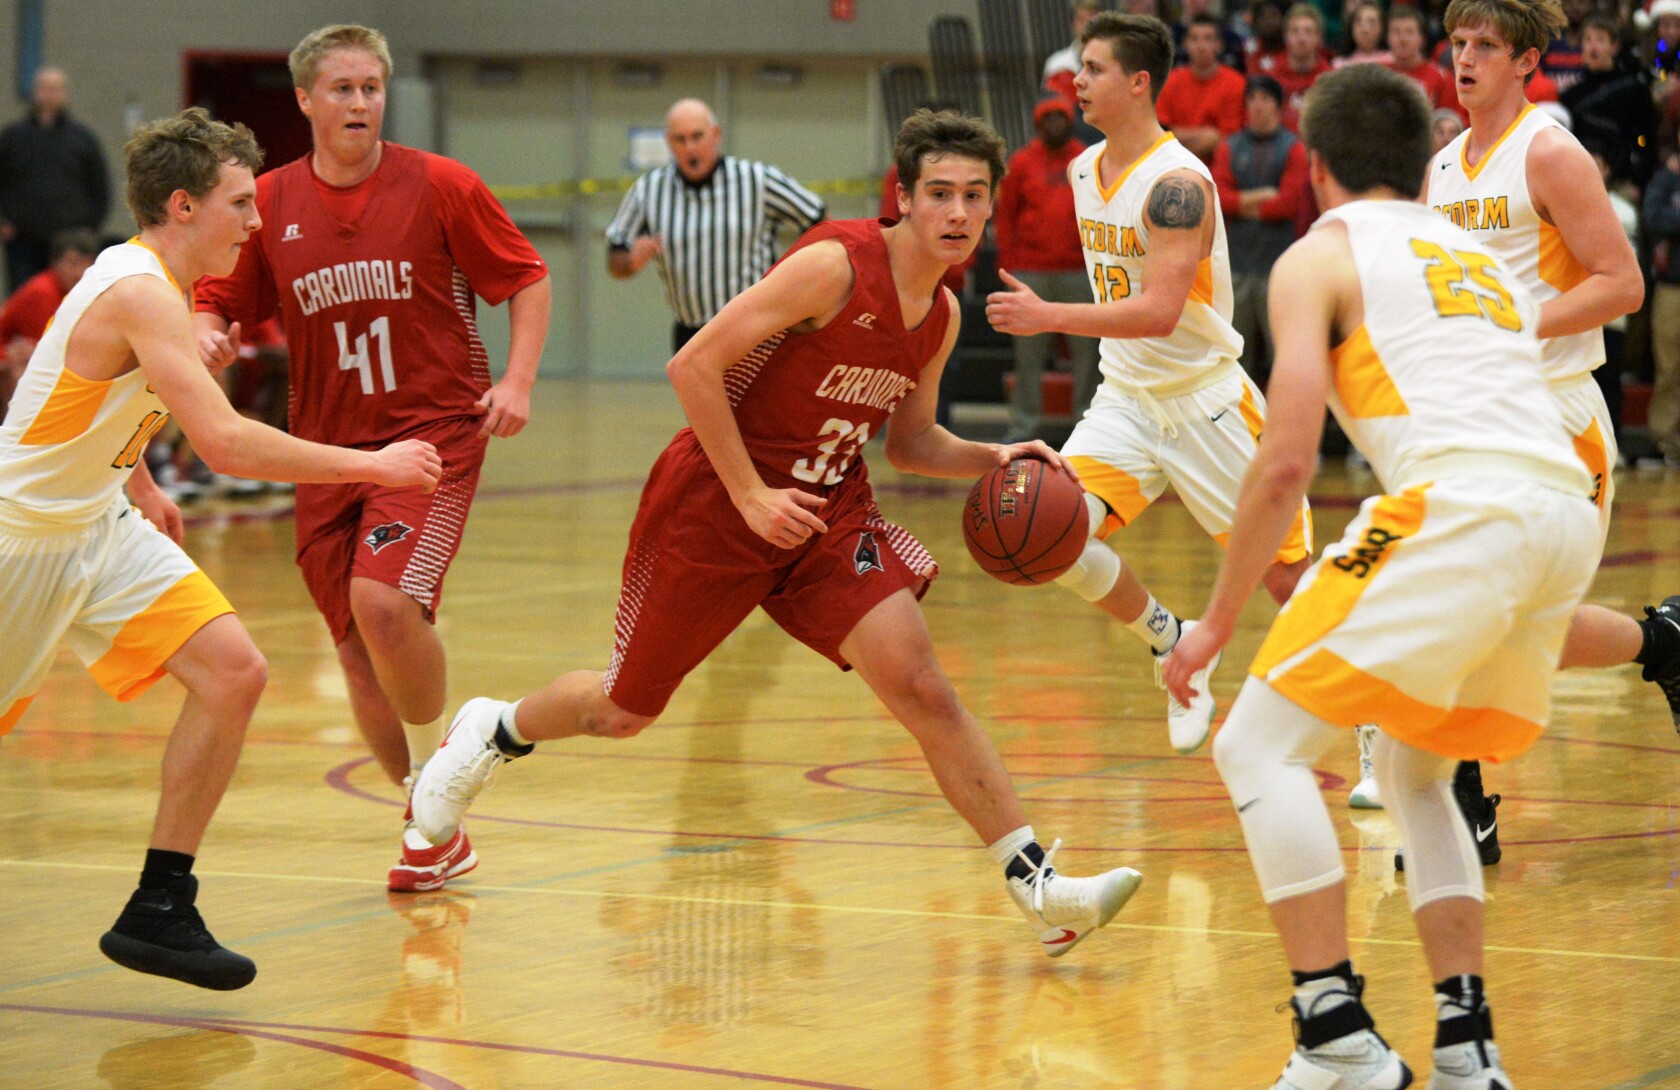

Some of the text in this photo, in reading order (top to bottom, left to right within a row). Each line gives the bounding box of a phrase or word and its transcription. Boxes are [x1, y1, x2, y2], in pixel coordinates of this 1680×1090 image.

[292, 259, 413, 316] CARDINALS
[1093, 263, 1130, 304] 12
[1409, 237, 1523, 333] 25
[333, 316, 397, 395] 41
